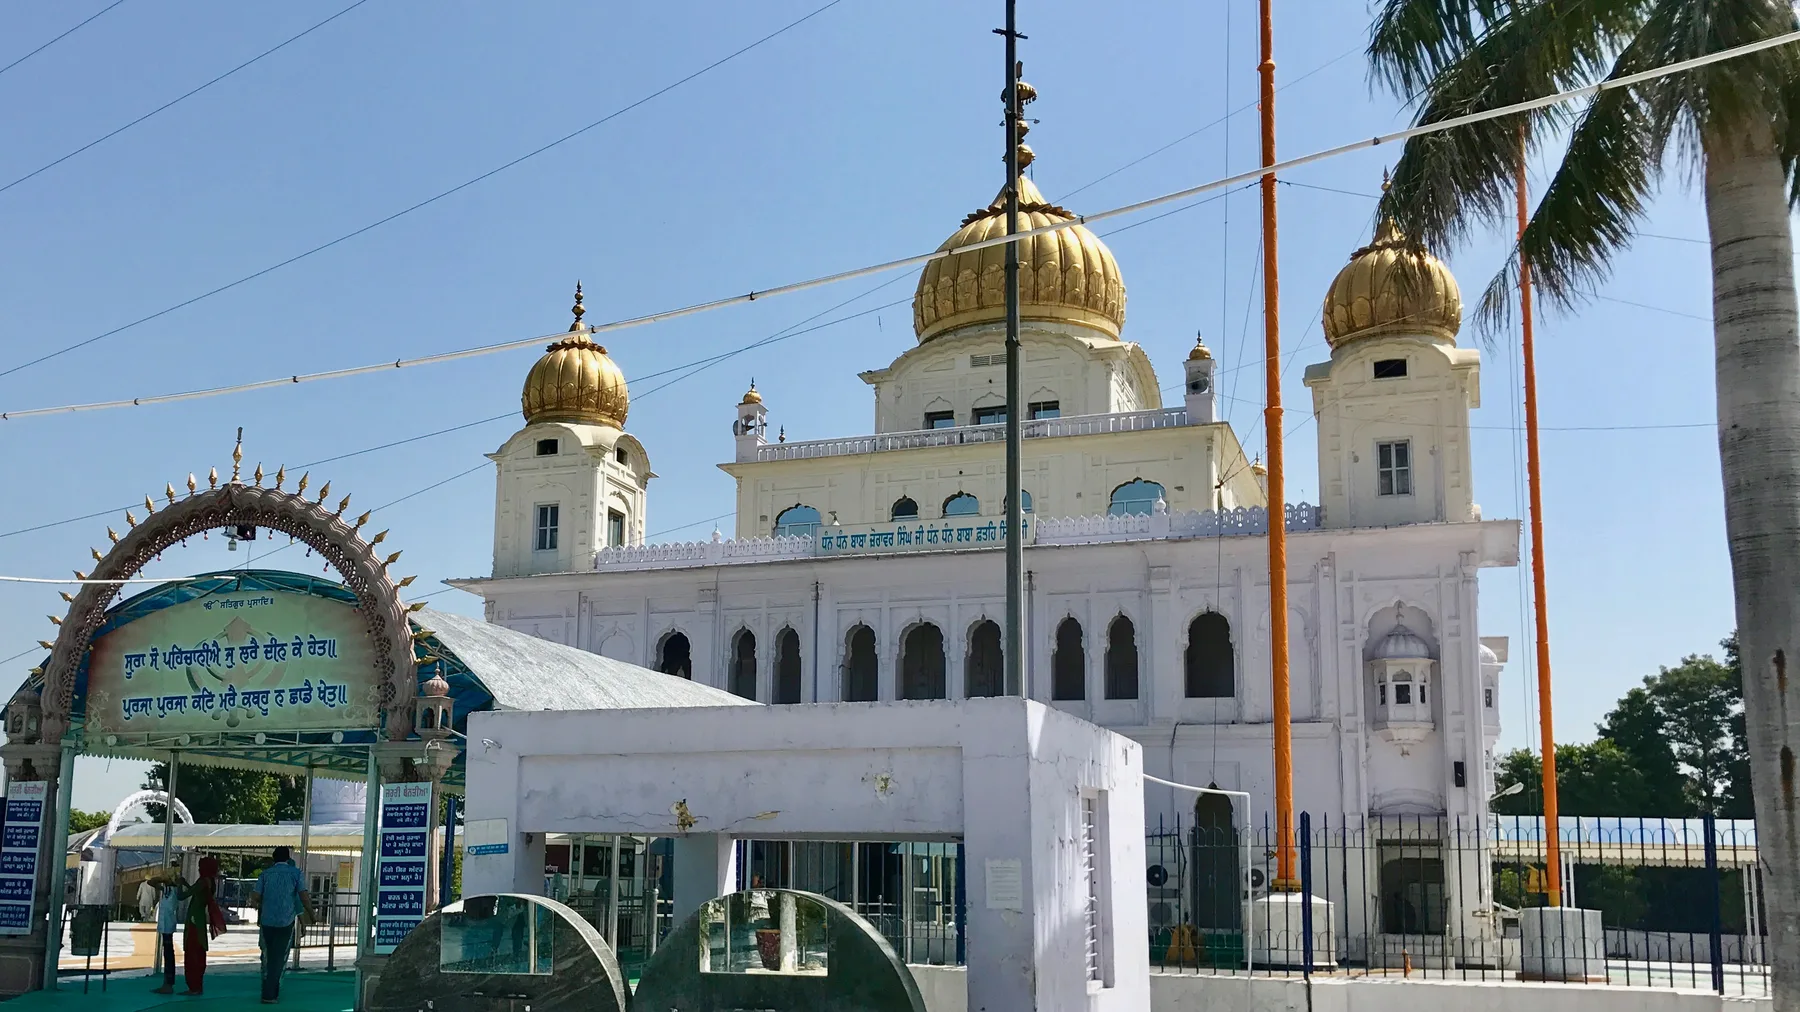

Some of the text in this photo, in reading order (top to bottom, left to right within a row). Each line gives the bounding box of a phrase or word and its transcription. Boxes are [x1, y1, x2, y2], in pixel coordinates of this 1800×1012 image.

[822, 530, 833, 550] ਧੰਨ
[836, 530, 848, 549] ਧੰਨ
[851, 534, 867, 548] ਬਾਬਾ
[897, 525, 912, 546] ਸਿੰਘ
[915, 525, 924, 545] ਜੀ
[927, 524, 939, 544] ਧੰਨ
[942, 523, 954, 543] ਧੰਨ
[957, 528, 973, 542] ਬਾਬਾ
[220, 599, 244, 609] ਸਤਿਗੁਰ
[124, 654, 146, 679] ਸੂਰਾ
[150, 646, 159, 671] ਸੋ
[225, 647, 235, 668] ਜੁ
[239, 637, 260, 664] ਲਰੈ
[263, 637, 288, 662] ਦੀਨ
[291, 635, 303, 658] ਕੇ
[123, 698, 153, 720] ਪੁਰਜਾ
[157, 696, 188, 718] ਪੁਰਜਾ
[192, 687, 215, 713] ਕਟਿ
[219, 684, 237, 711] ਮਰੈ
[241, 690, 270, 716] ਕਬਹੂ
[274, 689, 285, 707] ਨ
[289, 679, 313, 705] ਛਾਡੈ
